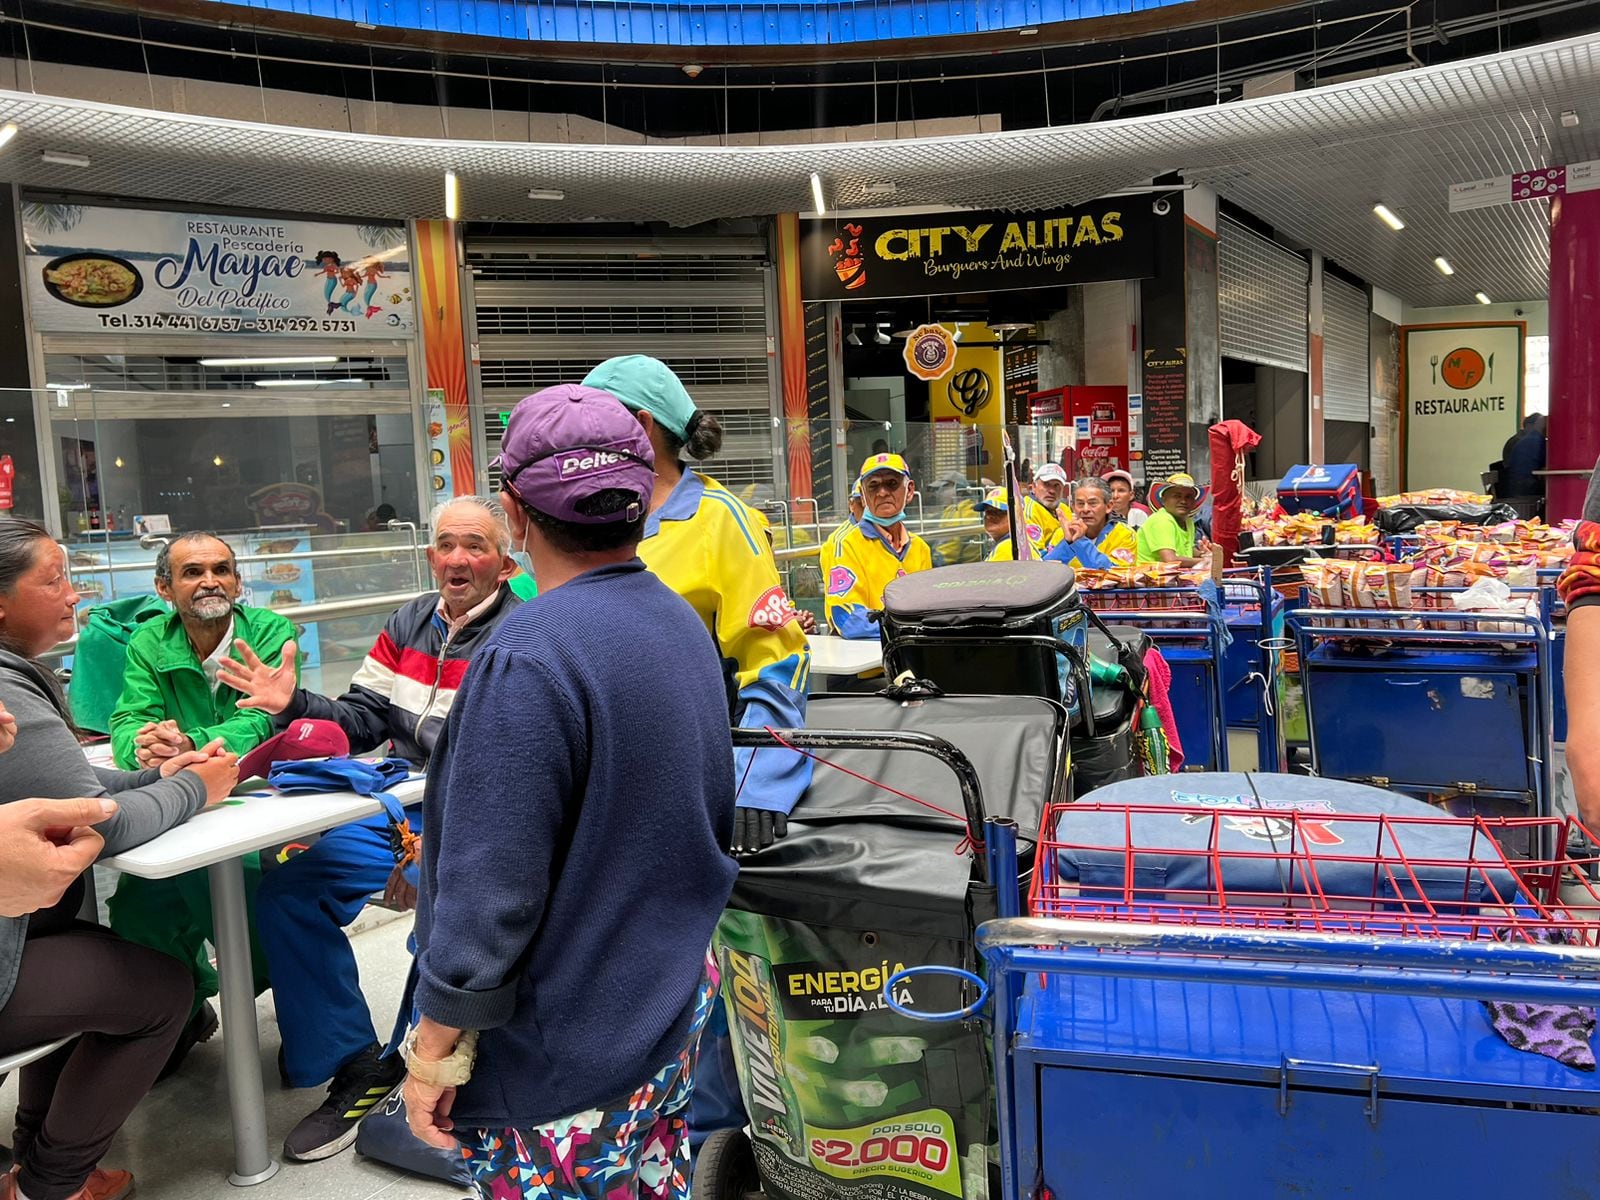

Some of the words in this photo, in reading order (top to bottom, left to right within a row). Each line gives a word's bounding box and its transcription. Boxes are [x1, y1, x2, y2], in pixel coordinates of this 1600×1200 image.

[187, 220, 285, 239] RESTAURANTE
[875, 222, 995, 261] CITY
[1000, 211, 1124, 253] ALITAS
[222, 236, 304, 254] Pescadería
[154, 237, 305, 298] Mayae
[923, 259, 990, 280] Burguers
[991, 251, 1024, 272] And
[1026, 252, 1072, 273] Wings
[177, 286, 214, 309] Del
[166, 315, 197, 330] 441
[200, 316, 241, 332] 6757
[257, 318, 286, 332] 314
[288, 318, 319, 333] 292
[321, 319, 357, 334] 5731
[924, 328, 947, 340] busca
[1414, 396, 1505, 416] RESTAURANTE
[788, 959, 912, 996] ENERGÍA
[811, 998, 833, 1006] PARA
[823, 1005, 835, 1013] TU
[834, 993, 868, 1013] DÍA
[868, 1001, 878, 1011] A
[759, 980, 784, 1077] ORIGINAL
[872, 1125, 903, 1135] POR
[904, 1122, 942, 1134] SOLO
[810, 1133, 949, 1173] $2.000
[852, 1164, 887, 1176] PRECIO
[887, 1165, 933, 1181] SUGERIDO
